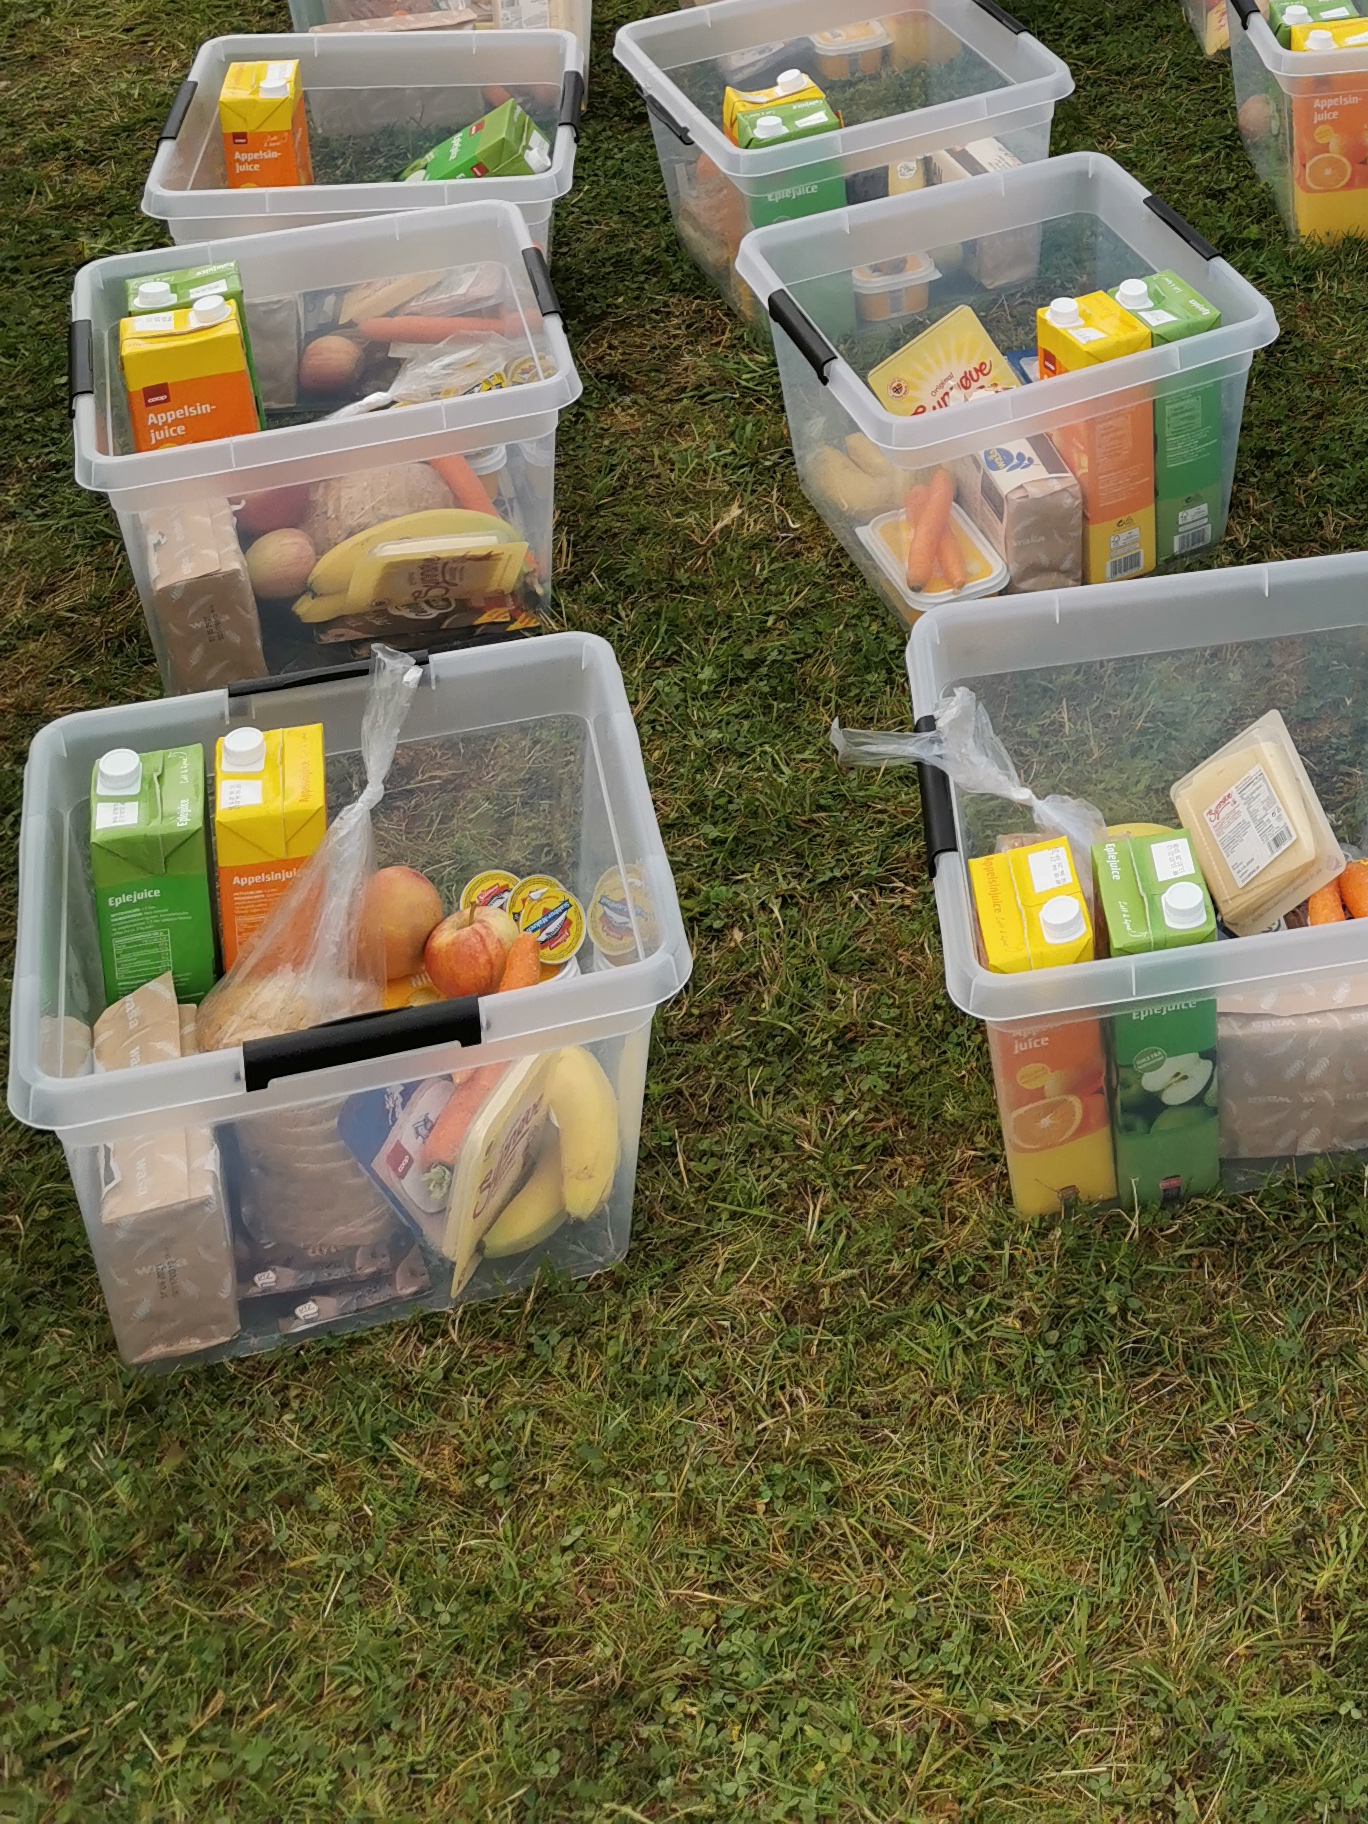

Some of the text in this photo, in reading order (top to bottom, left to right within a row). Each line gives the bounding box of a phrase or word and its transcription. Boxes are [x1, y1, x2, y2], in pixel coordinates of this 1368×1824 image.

[1313, 95, 1363, 109] Appelsin-
[1313, 110, 1339, 124] juice
[234, 150, 282, 162] Appelsin-
[235, 162, 260, 174] juice
[930, 371, 954, 397] Original
[147, 394, 167, 404] coop
[147, 402, 216, 426] Appelsin-
[150, 424, 186, 445] juice
[176, 797, 191, 828] Eplejuice
[1103, 843, 1121, 881] Eplejuice
[984, 857, 1002, 913] Appelsinjuice
[107, 887, 161, 908] Eplejuice
[1013, 1036, 1050, 1055] juice
[398, 1154, 410, 1173] coop
